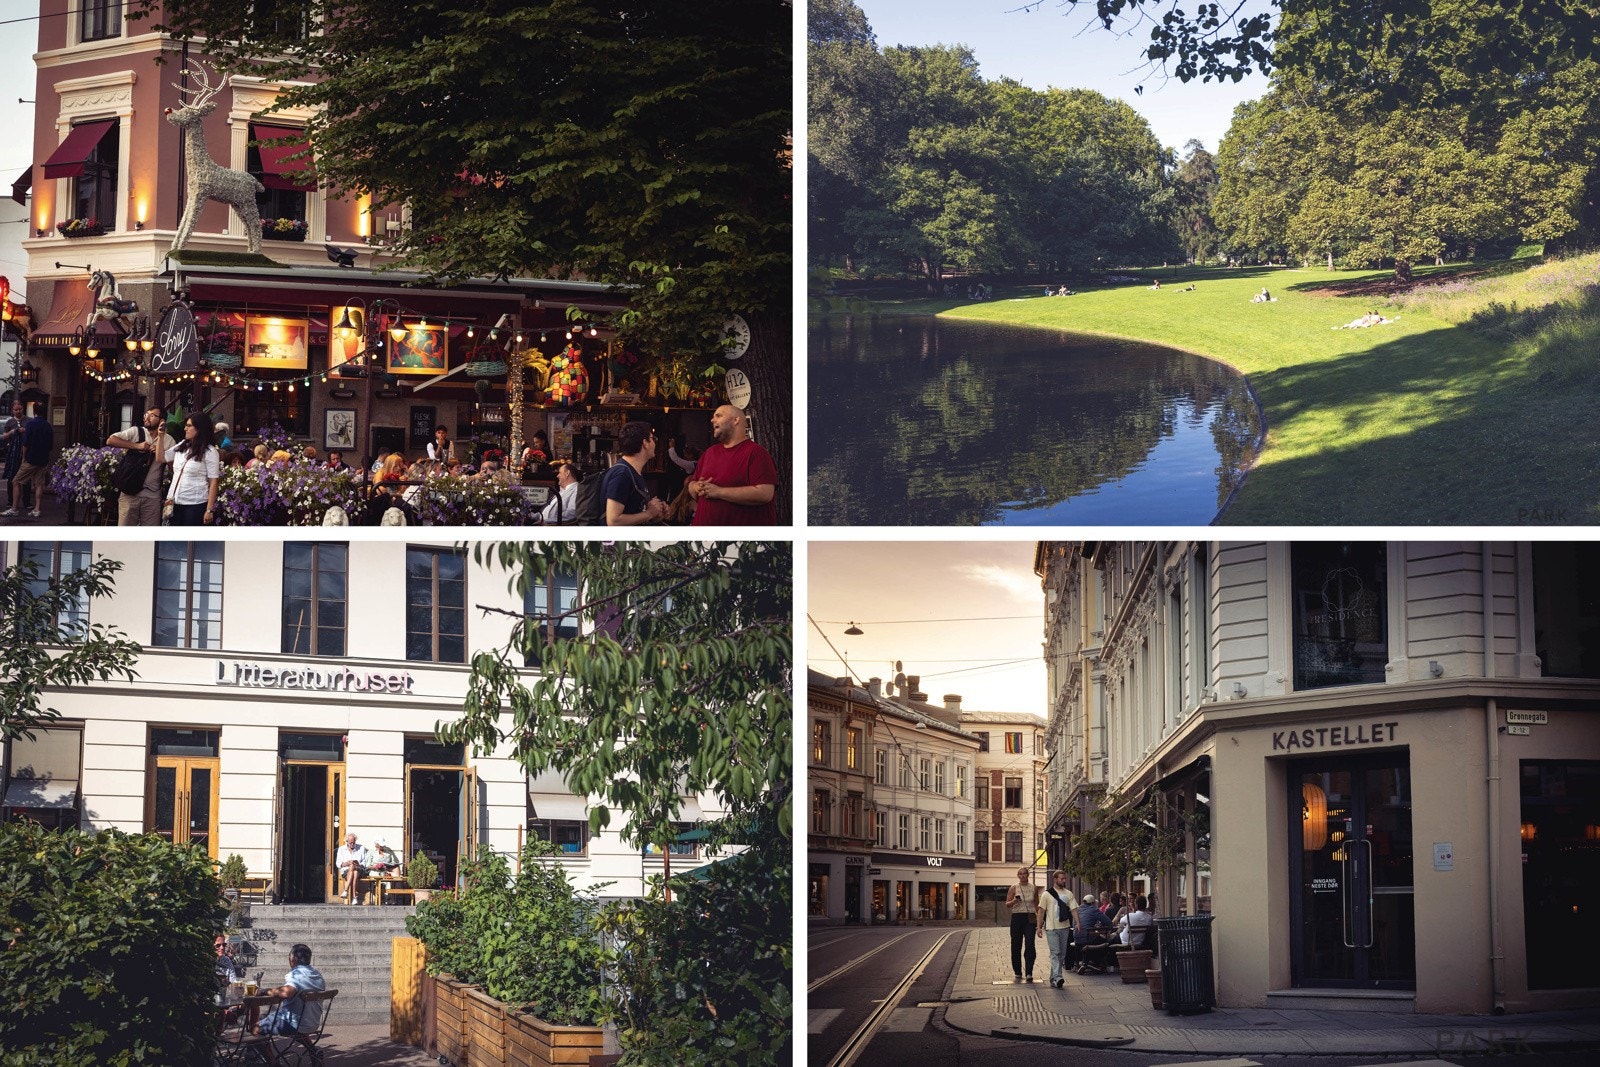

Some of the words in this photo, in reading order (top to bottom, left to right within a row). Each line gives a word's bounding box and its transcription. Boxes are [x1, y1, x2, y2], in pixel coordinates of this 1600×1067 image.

[726, 372, 746, 389] H12
[414, 412, 431, 420] FLESK
[215, 659, 414, 693] Litteraturhuset
[1509, 711, 1546, 722] Grønnegata
[1272, 722, 1399, 751] KASTELLET
[845, 856, 865, 865] GANNI
[926, 857, 943, 867] VOLT
